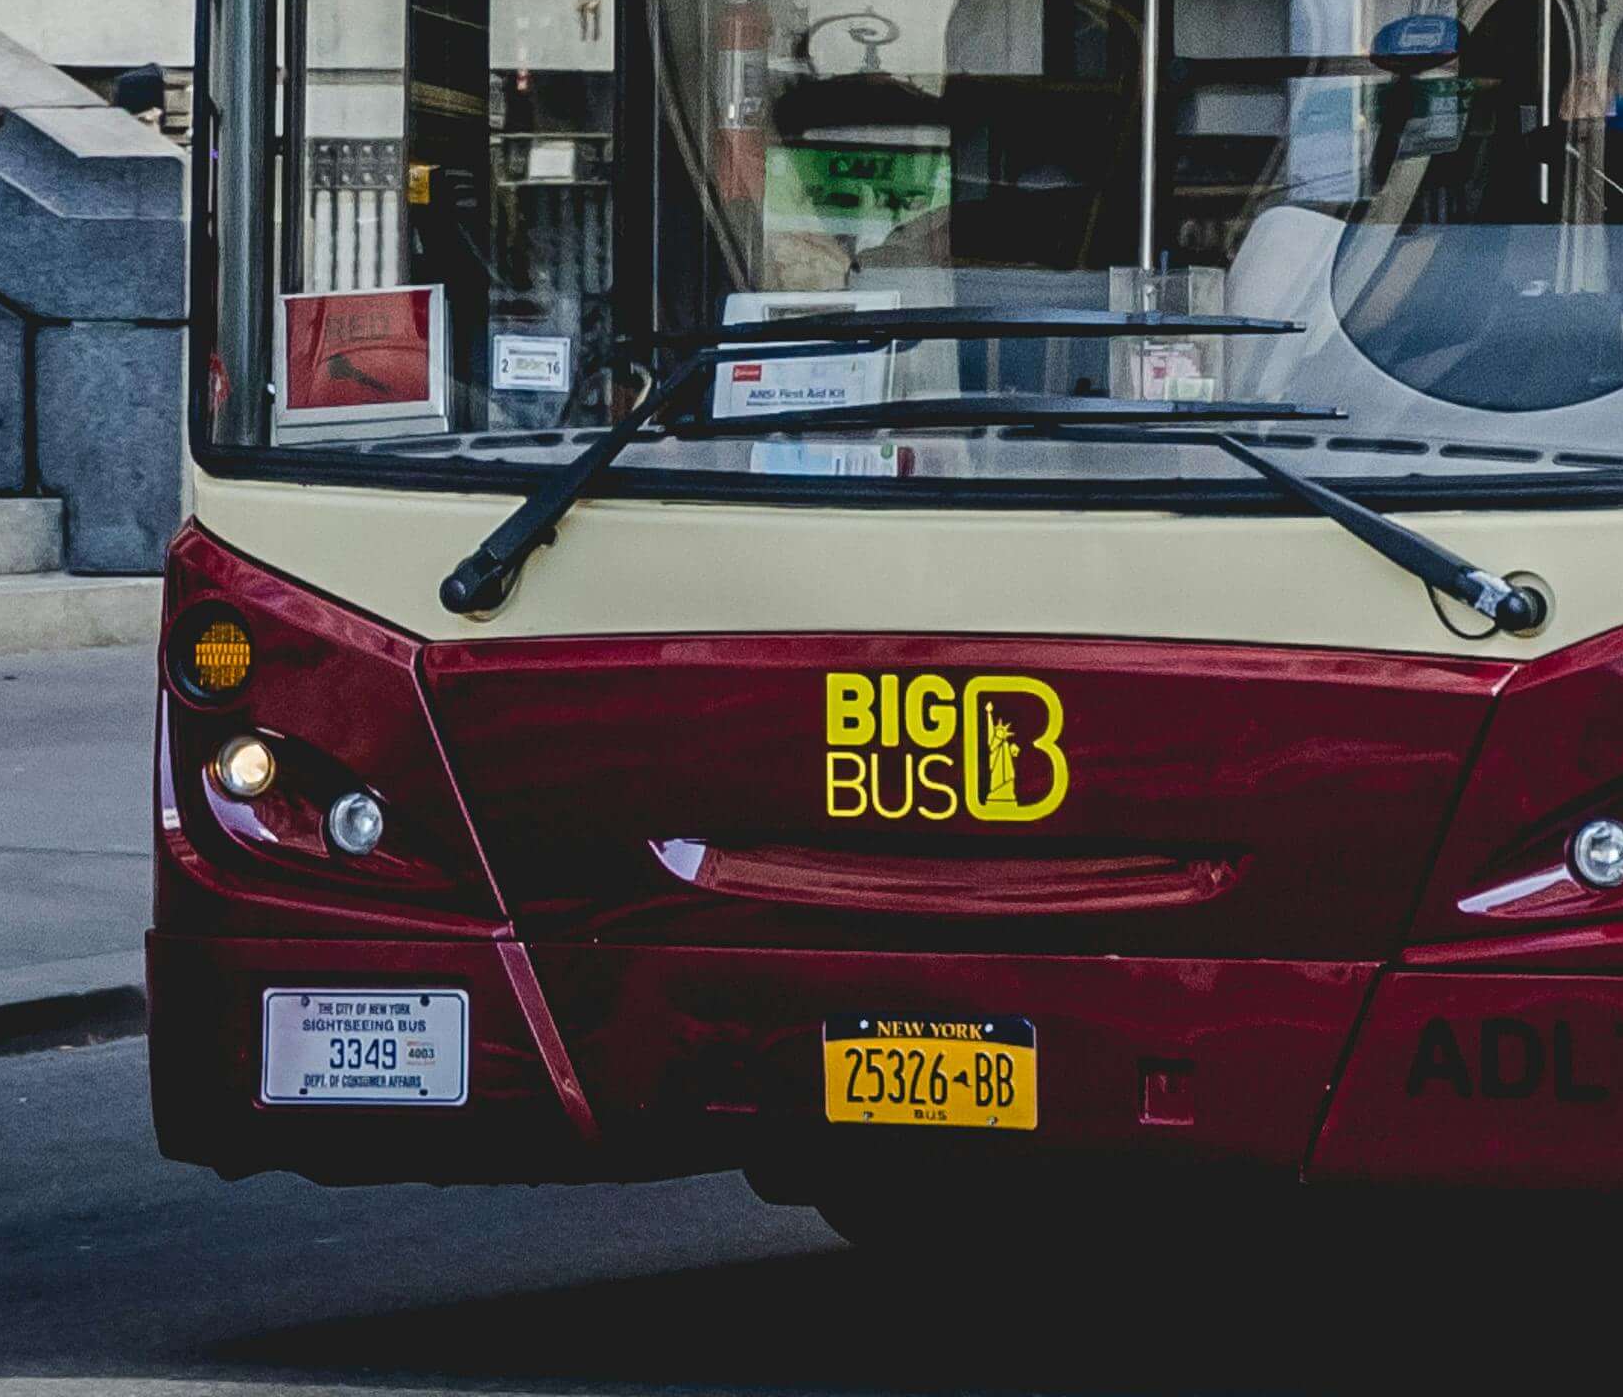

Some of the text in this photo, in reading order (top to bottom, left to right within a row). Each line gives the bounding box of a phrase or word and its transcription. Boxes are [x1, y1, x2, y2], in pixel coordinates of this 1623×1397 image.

[826, 674, 955, 748] BIG
[827, 753, 956, 819] BUS
[369, 1003, 388, 1015] NEW
[389, 1004, 411, 1015] YORK
[302, 1019, 427, 1033] SIGHTSEEING BUS
[877, 1020, 983, 1040] NEW YORK
[329, 1038, 398, 1070] 3349
[329, 1075, 340, 1087] OF
[389, 1075, 422, 1088] AFFAIRS
[913, 1109, 947, 1121] BUS
